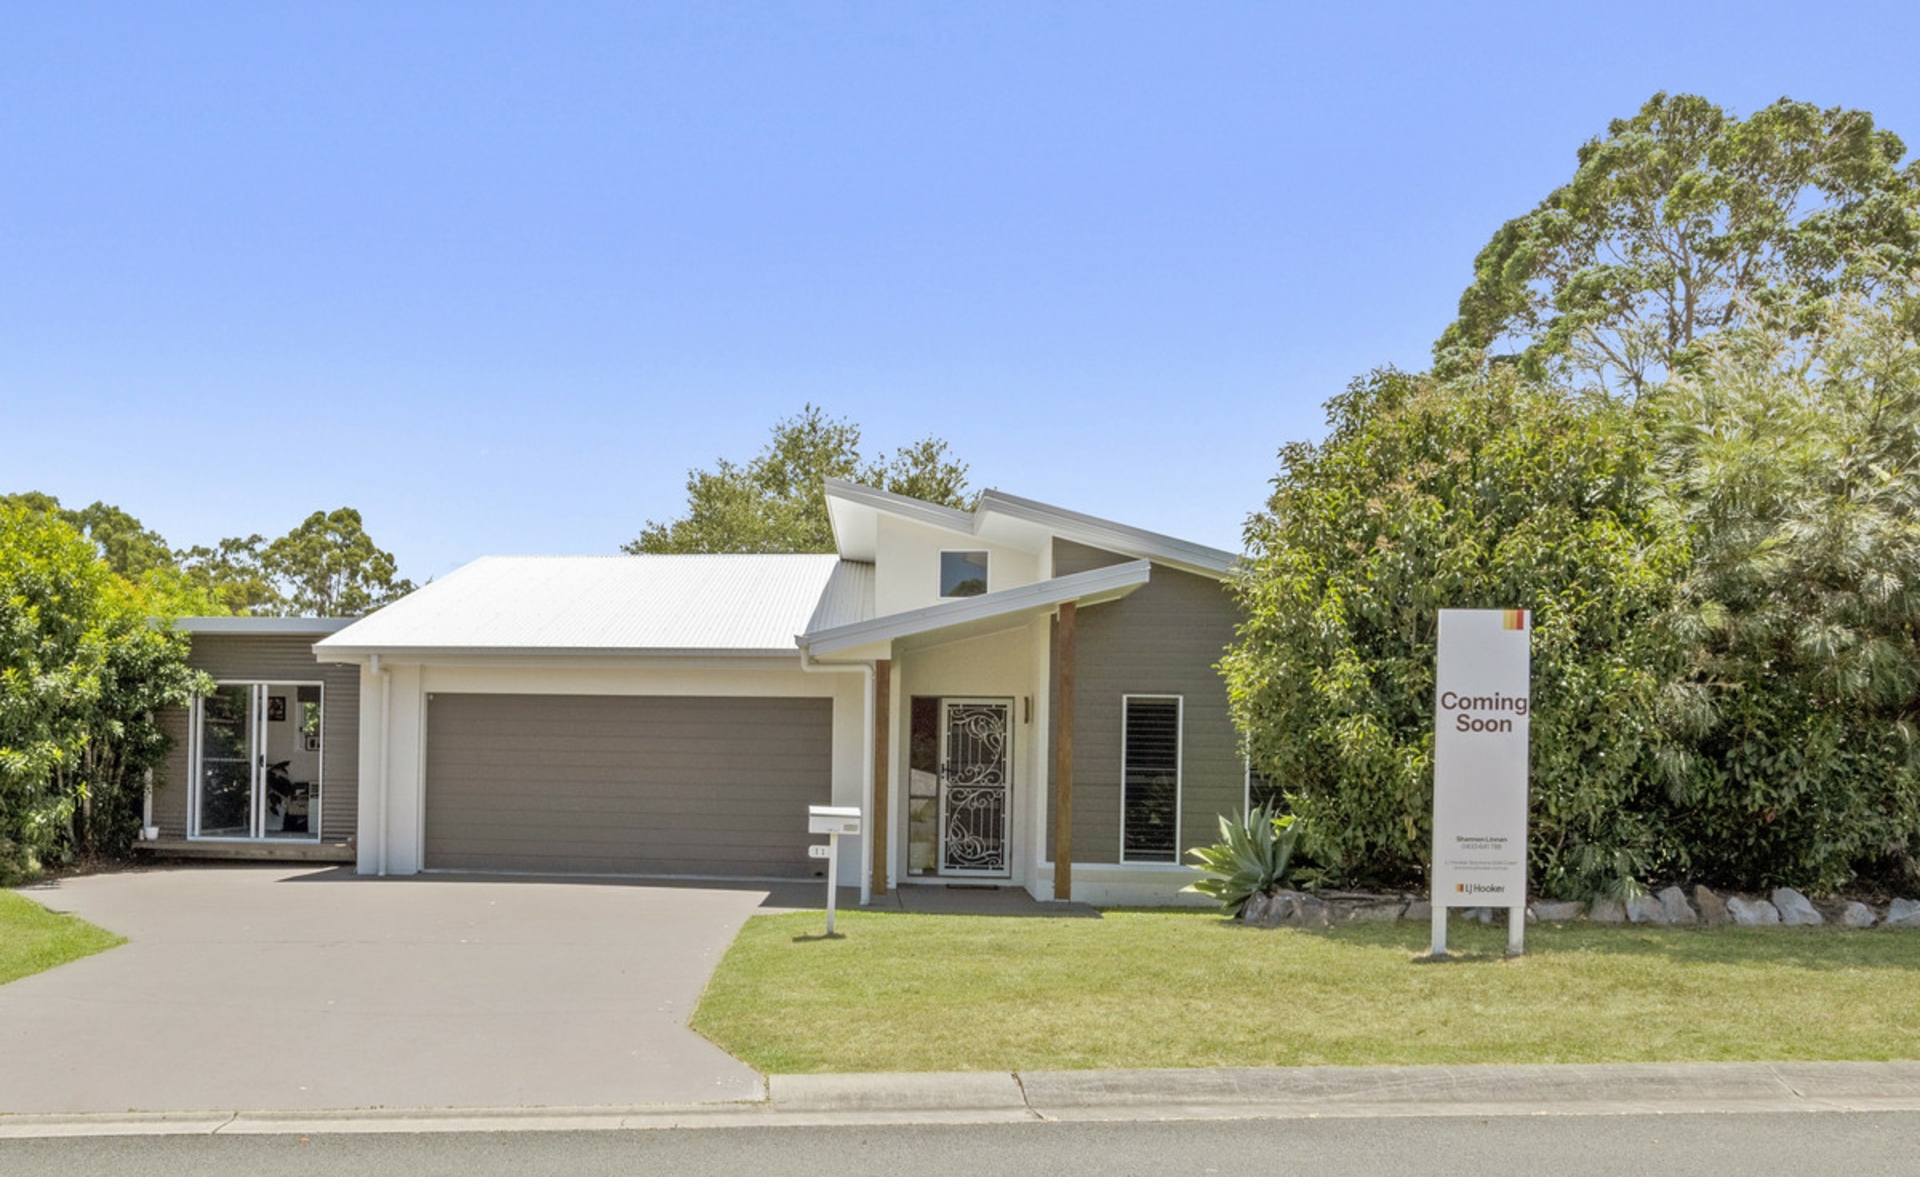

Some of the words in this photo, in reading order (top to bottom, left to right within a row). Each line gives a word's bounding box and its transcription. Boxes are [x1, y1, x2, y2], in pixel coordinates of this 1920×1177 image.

[1441, 691, 1527, 715] Coming
[1456, 713, 1512, 732] Soon
[1465, 884, 1473, 894] LJ
[1474, 884, 1505, 893] Hooker
